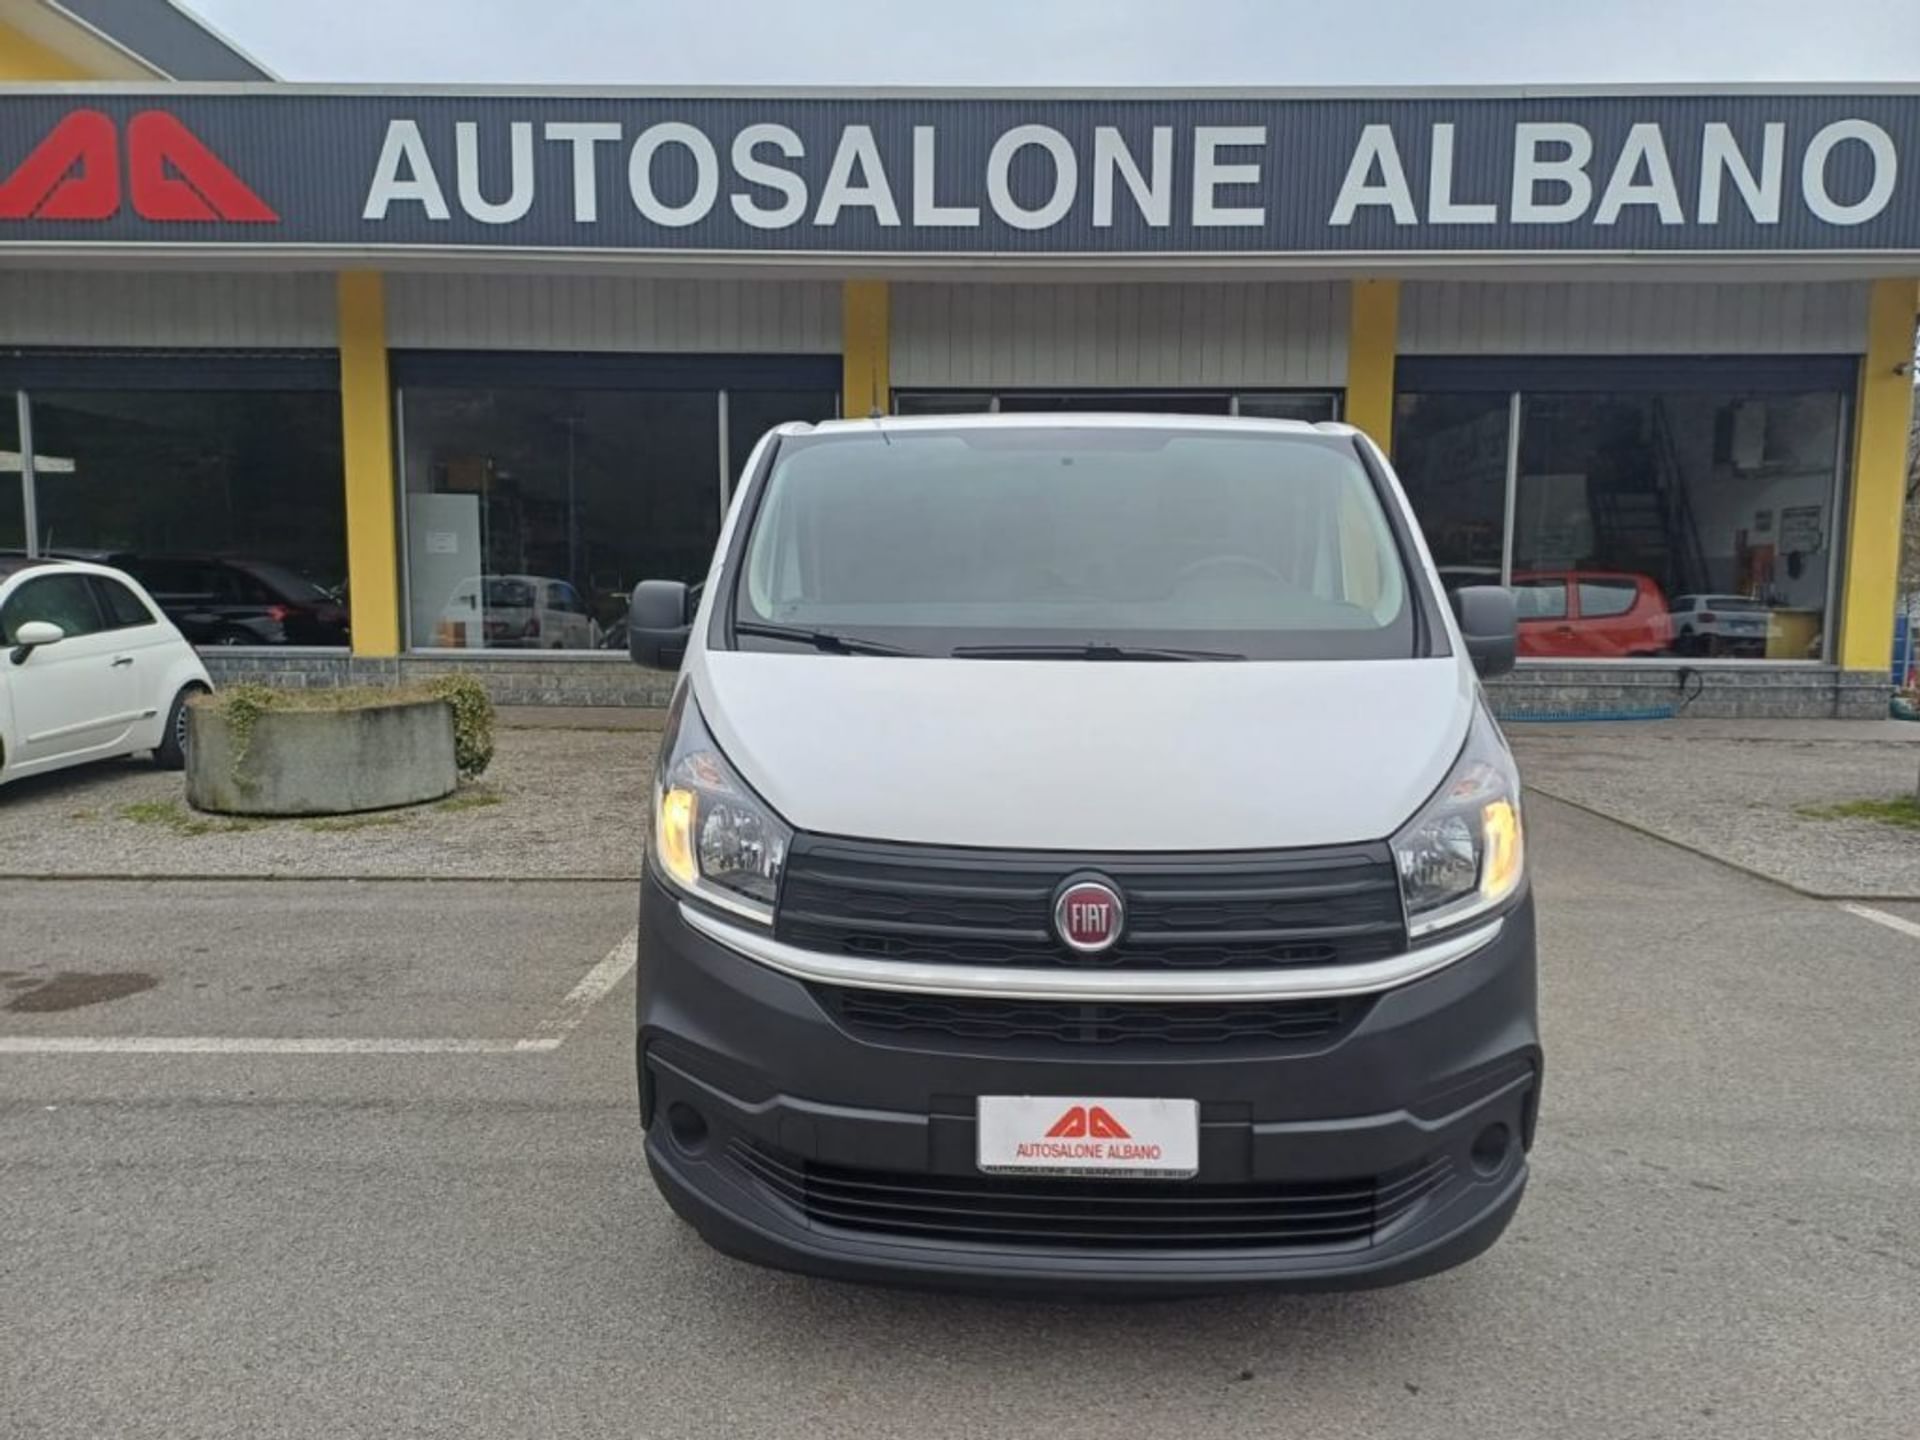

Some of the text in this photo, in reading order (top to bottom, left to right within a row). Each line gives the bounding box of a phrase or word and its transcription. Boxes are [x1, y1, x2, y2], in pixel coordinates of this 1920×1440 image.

[363, 118, 1898, 230] AUTOSALONE ALBANO
[1071, 903, 1109, 933] FIAT
[1016, 1142, 1162, 1160] AUTOSALONE ALBANO
